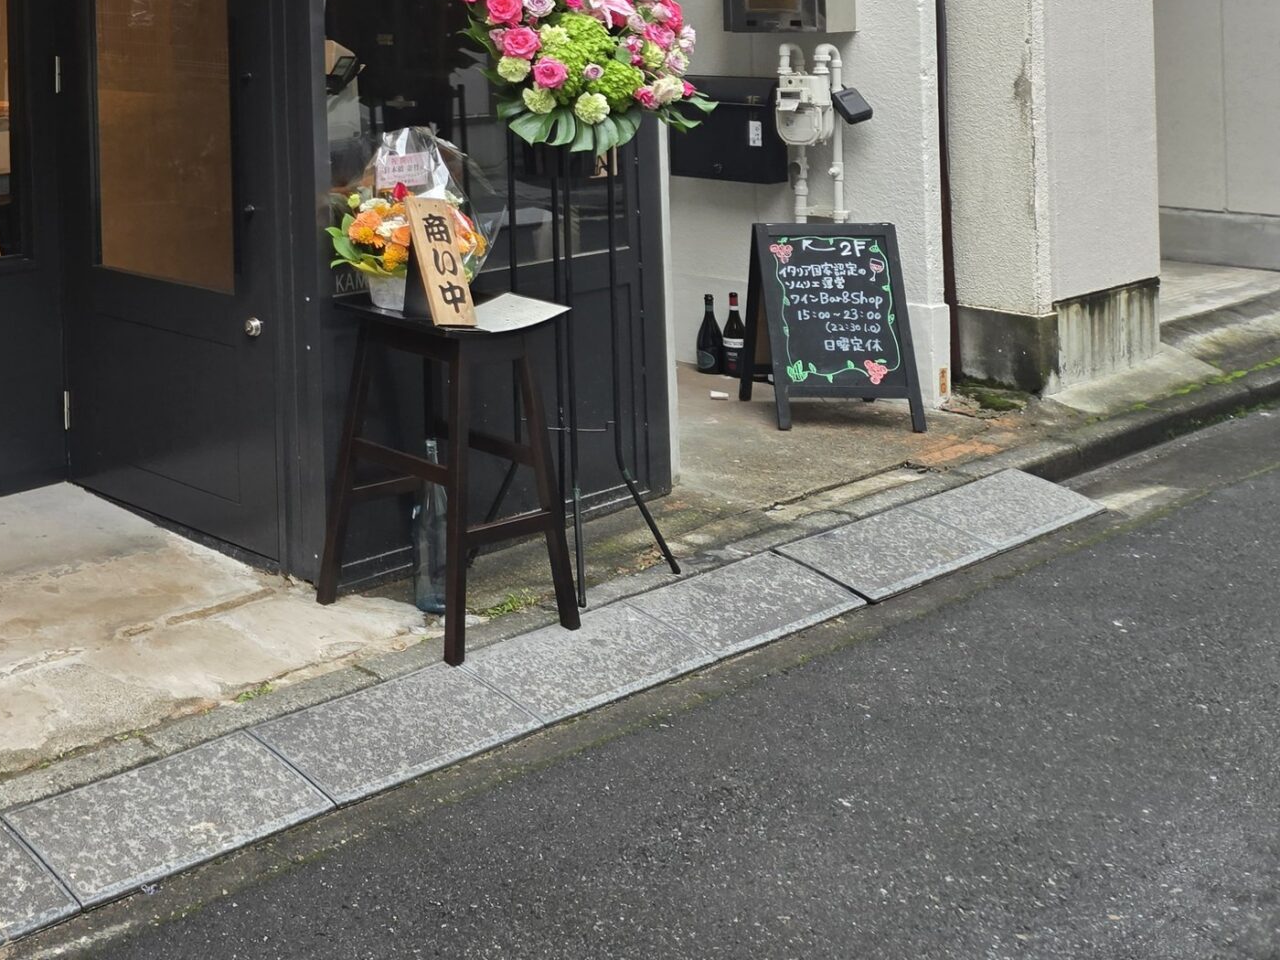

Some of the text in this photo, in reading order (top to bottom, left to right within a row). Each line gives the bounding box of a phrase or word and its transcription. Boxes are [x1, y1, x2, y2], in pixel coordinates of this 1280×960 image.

[840, 240, 866, 257] 2F
[422, 213, 467, 314] 商い中
[824, 336, 883, 352] 日曜定休
